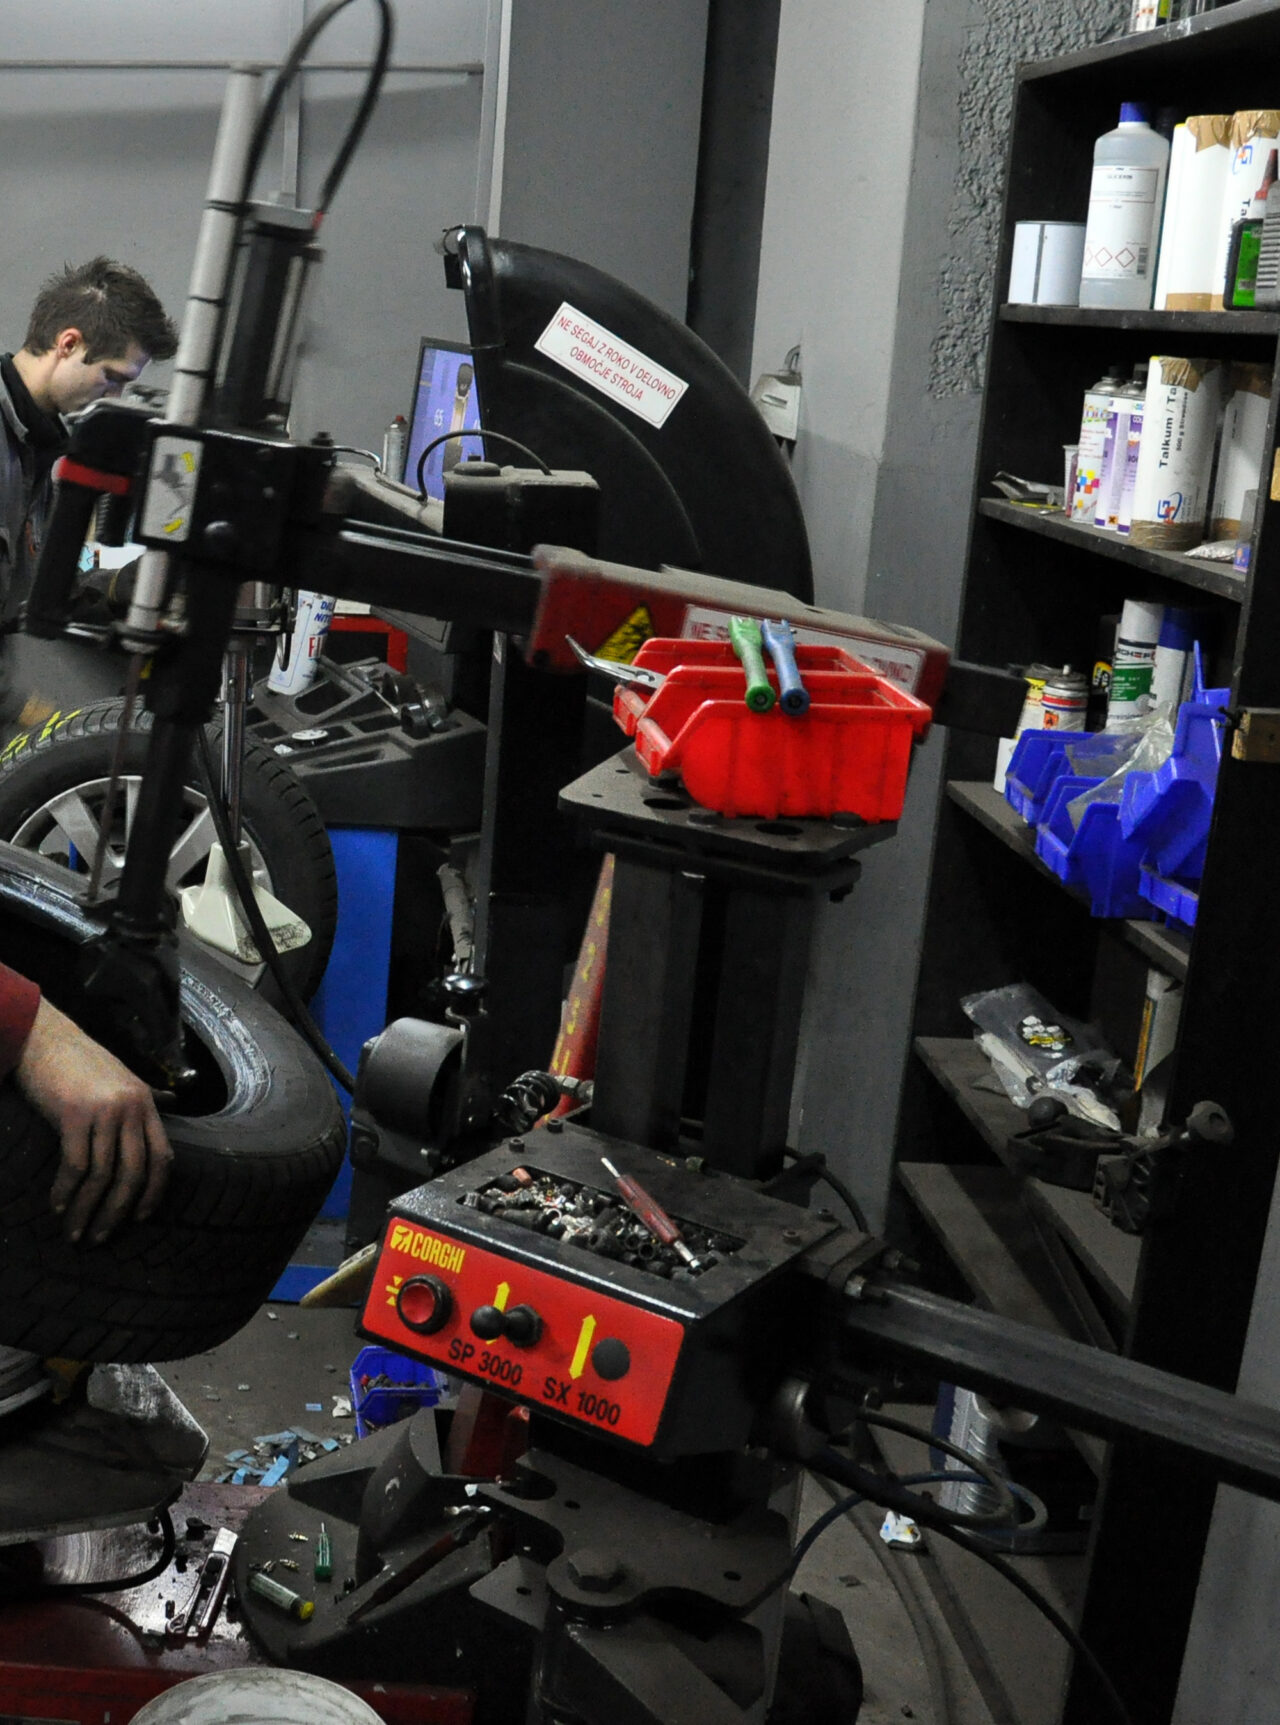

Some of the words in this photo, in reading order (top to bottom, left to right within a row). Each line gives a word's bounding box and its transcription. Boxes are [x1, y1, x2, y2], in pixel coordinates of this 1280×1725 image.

[558, 316, 573, 332] NE
[571, 325, 599, 349] SEGAJ
[597, 344, 607, 354] Z
[605, 347, 631, 370] ROKO
[629, 362, 638, 374] V
[635, 368, 676, 400] DELOVNO
[569, 346, 613, 381] OBMOČJE
[610, 373, 644, 401] STROJA
[1158, 417, 1174, 468] Talkum
[1166, 386, 1178, 404] Ta
[410, 1231, 466, 1274] CORGHI
[448, 1338, 475, 1363] SP
[478, 1350, 523, 1386] 3000
[542, 1376, 572, 1405] SX
[578, 1390, 622, 1426] 1000
